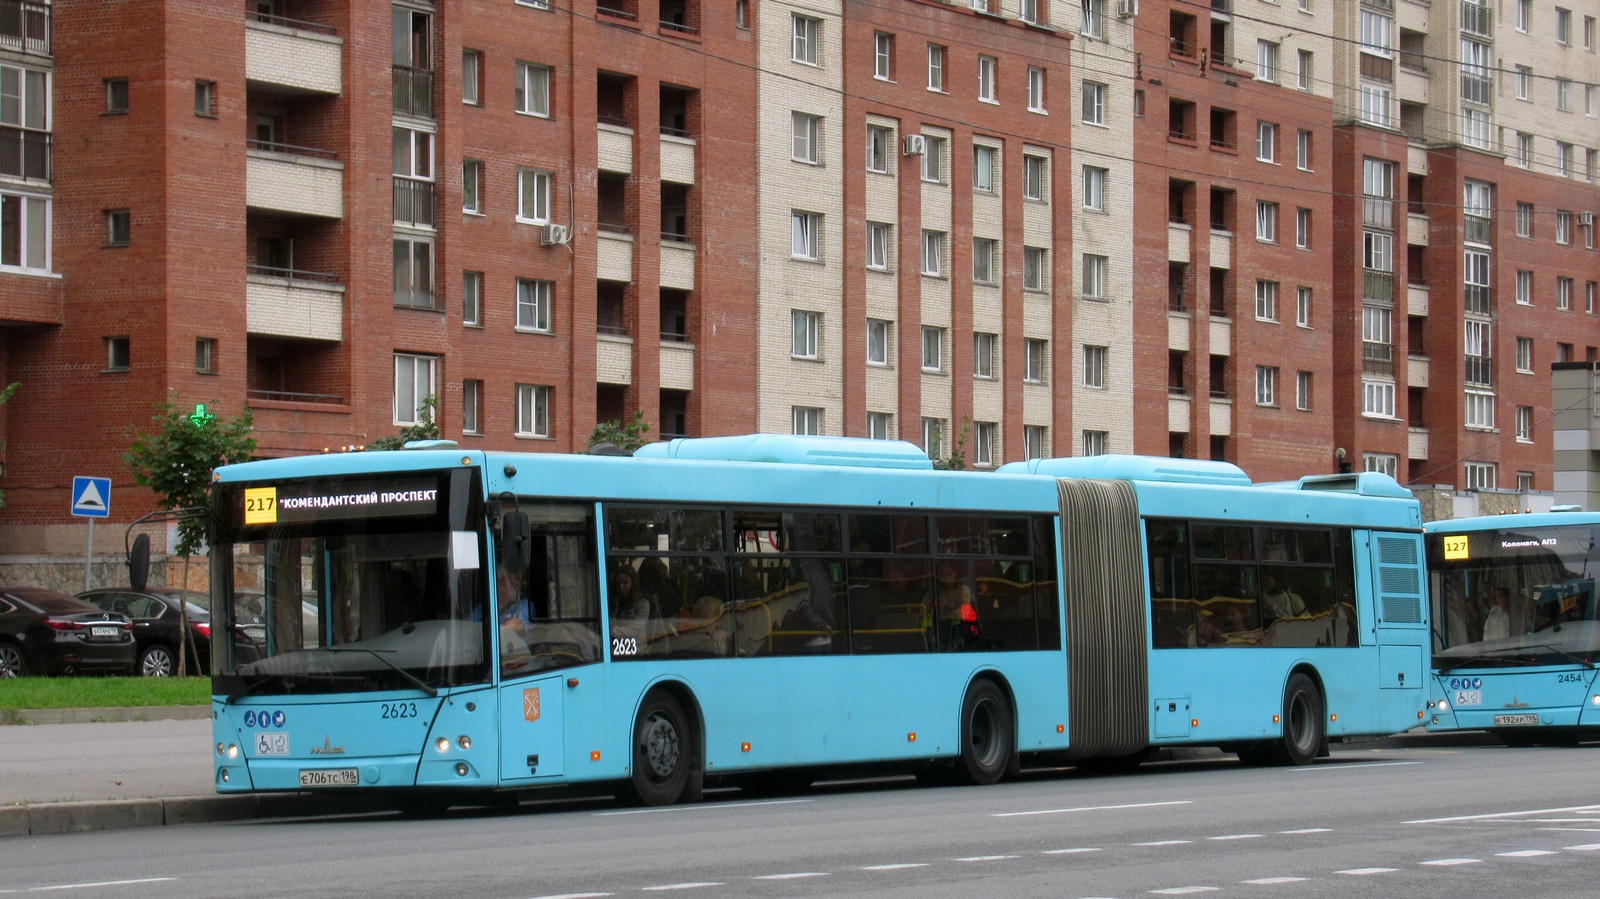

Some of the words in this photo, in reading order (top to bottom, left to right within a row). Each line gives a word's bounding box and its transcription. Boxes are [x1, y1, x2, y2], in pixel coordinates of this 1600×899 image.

[381, 490, 437, 503] ПРОСПЕКТ
[246, 498, 274, 512] 217
[1445, 542, 1466, 552] 127
[612, 638, 637, 655] 2623
[1558, 674, 1582, 683] 2454
[381, 703, 418, 719] 2623
[301, 771, 339, 784] Е706ТС
[340, 771, 355, 780] 198
